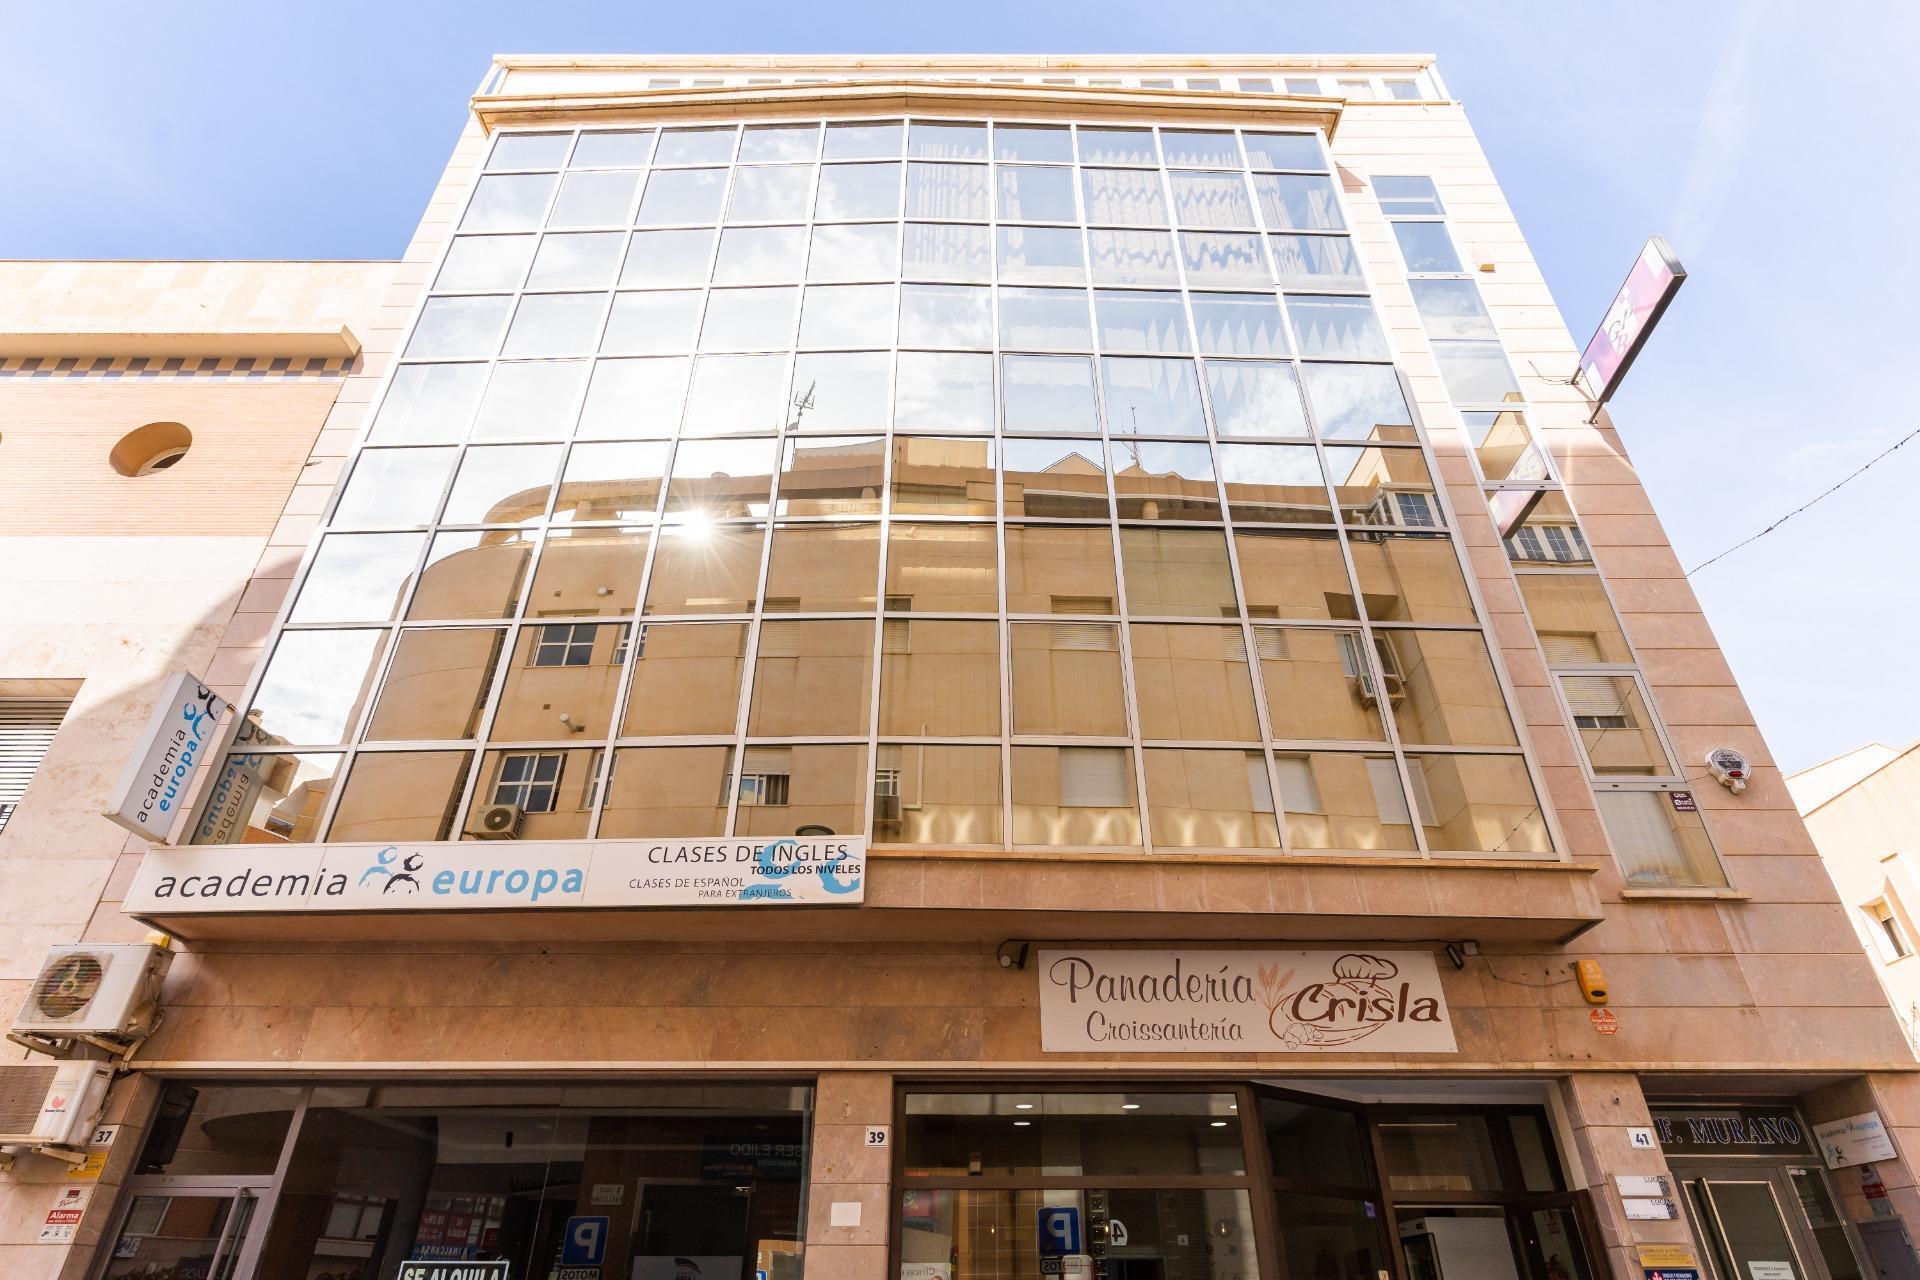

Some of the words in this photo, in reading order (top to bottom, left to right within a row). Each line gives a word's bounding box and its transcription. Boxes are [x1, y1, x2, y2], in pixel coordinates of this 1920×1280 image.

[137, 729, 186, 823] academia
[160, 740, 198, 811] europa
[648, 846, 727, 863] CLASES
[735, 846, 764, 863] DE
[771, 844, 848, 862] INGLES
[750, 866, 788, 875] TODOS
[791, 865, 812, 874] LOS
[815, 864, 861, 874] NIVELES
[154, 868, 348, 898] academia
[432, 865, 584, 902] europa
[629, 878, 671, 889] CLASES
[675, 878, 689, 888] DE
[693, 876, 745, 888] ESPAÑOL
[698, 889, 722, 898] PARA
[725, 888, 792, 898] EXTRANJEROS
[1049, 956, 1256, 1004] Panadería
[1291, 982, 1442, 1024] Crisla
[1086, 1010, 1244, 1042] Croissantería
[96, 1131, 113, 1143] 37
[868, 1131, 885, 1144] 39
[1655, 1117, 1683, 1144] F.
[1685, 1117, 1801, 1145] MURANO
[1635, 1133, 1650, 1146] 41
[49, 1211, 79, 1219] Alarma
[403, 1268, 426, 1280] SE
[430, 1268, 500, 1280] ALQUILA
